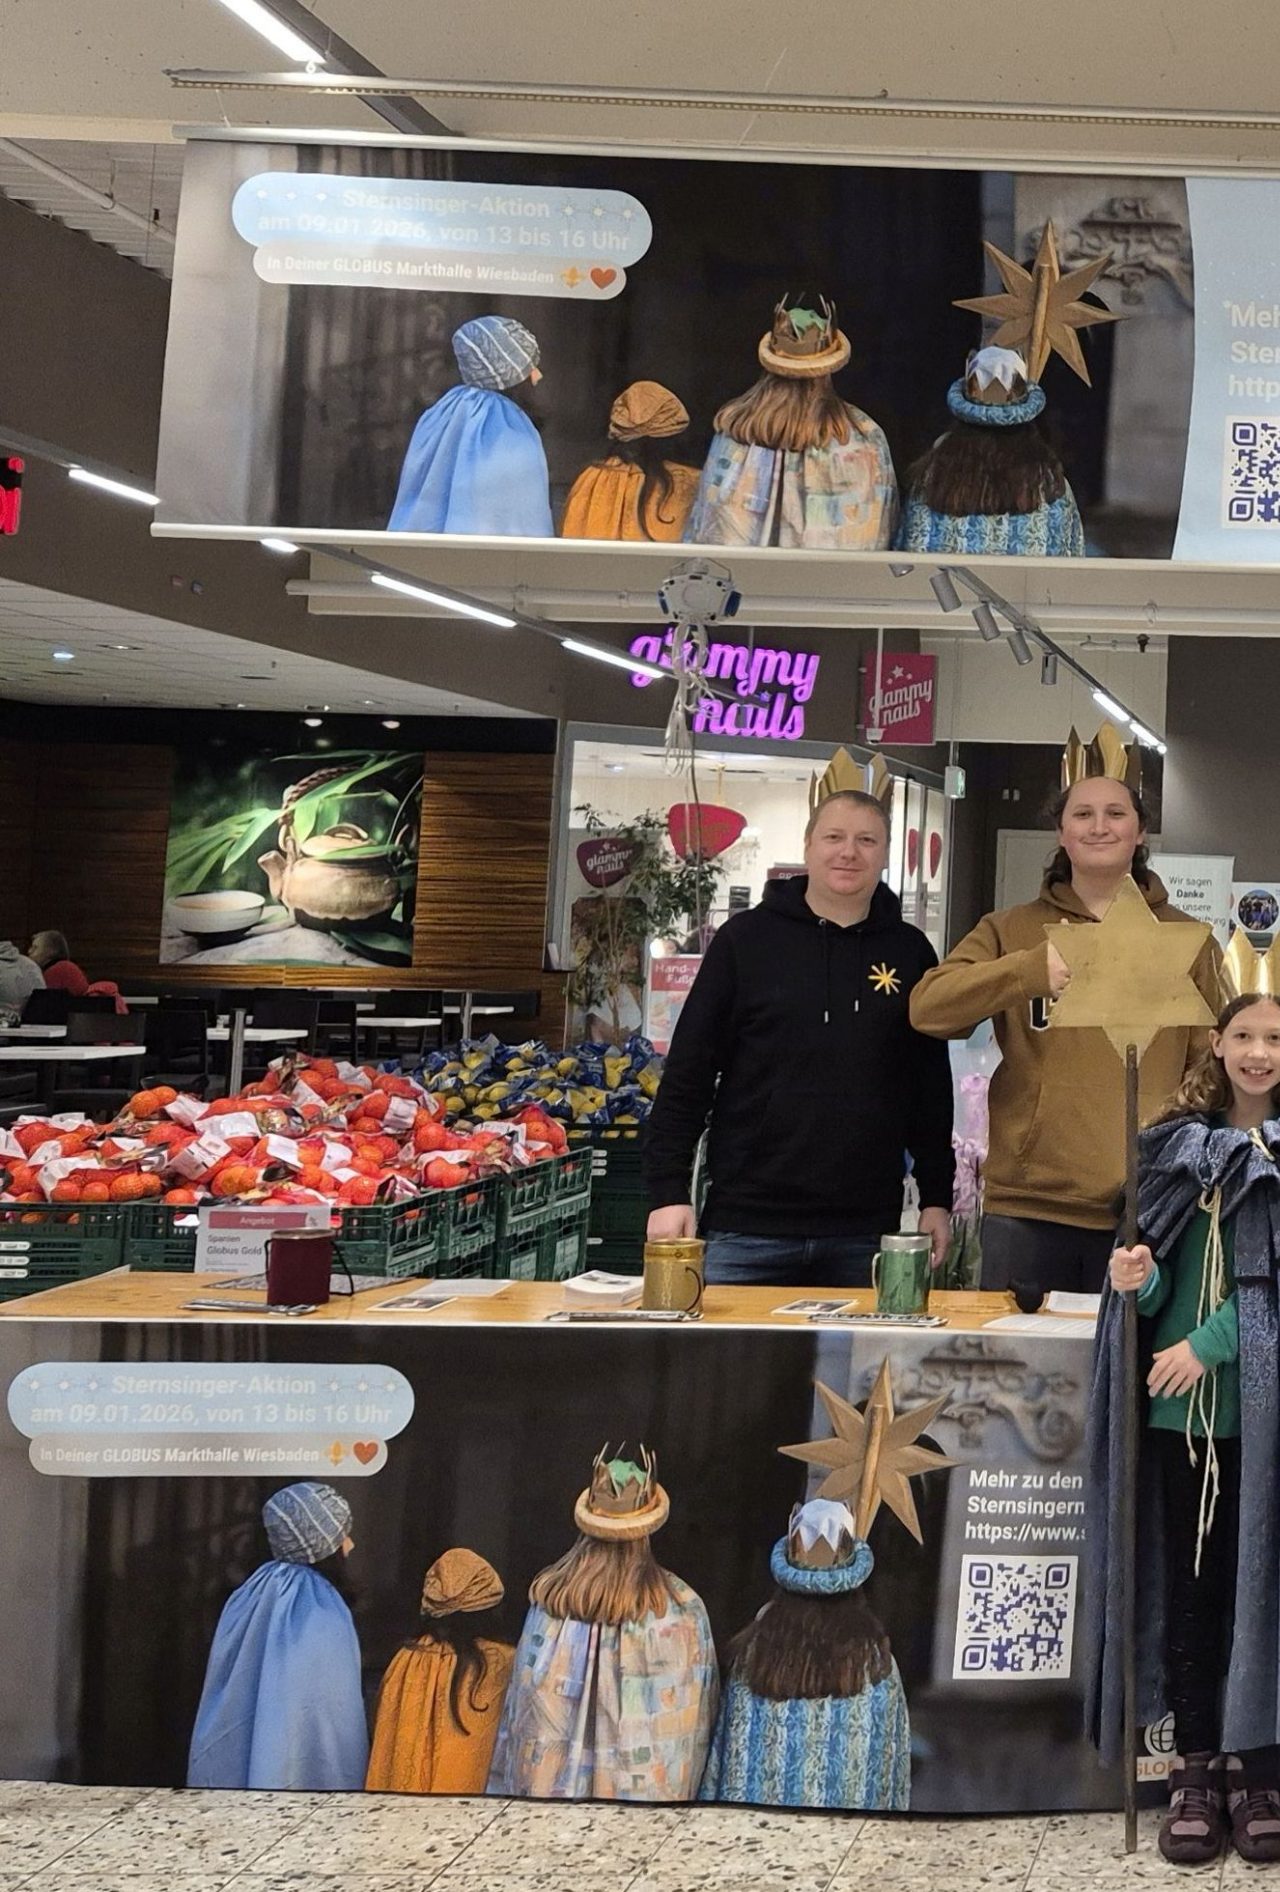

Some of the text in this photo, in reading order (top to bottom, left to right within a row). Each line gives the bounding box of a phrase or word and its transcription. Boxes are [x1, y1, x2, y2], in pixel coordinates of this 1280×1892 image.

[343, 188, 550, 220] Sternsinger-Aktion
[258, 215, 290, 231] am
[440, 226, 479, 243] von
[488, 226, 512, 245] 13
[519, 228, 550, 247] bis
[560, 231, 585, 249] 16
[593, 231, 630, 251] Uhr
[284, 256, 330, 272] Deiner
[333, 259, 392, 275] GLOBUS
[397, 261, 472, 281] Markthalle
[476, 265, 554, 285] Wiesbaden
[883, 700, 921, 725] nails
[1169, 876, 1213, 887] Wir sagen
[1176, 889, 1205, 899] Danke
[240, 1217, 276, 1227] Angebot
[208, 1234, 241, 1244] Spanien
[207, 1246, 262, 1255] Globus Gold
[112, 1375, 316, 1399] Sternsinger-Aktion
[31, 1403, 393, 1426] am 09.01.2026, von 13 bis 16 Uhr
[56, 1448, 99, 1462] Deiner
[103, 1448, 161, 1463] GLOBUS
[164, 1447, 238, 1463] Markthalle
[243, 1448, 320, 1463] Wiesbaden
[969, 1469, 1083, 1489] Mehr zu den
[967, 1496, 1084, 1519] Sternsingern
